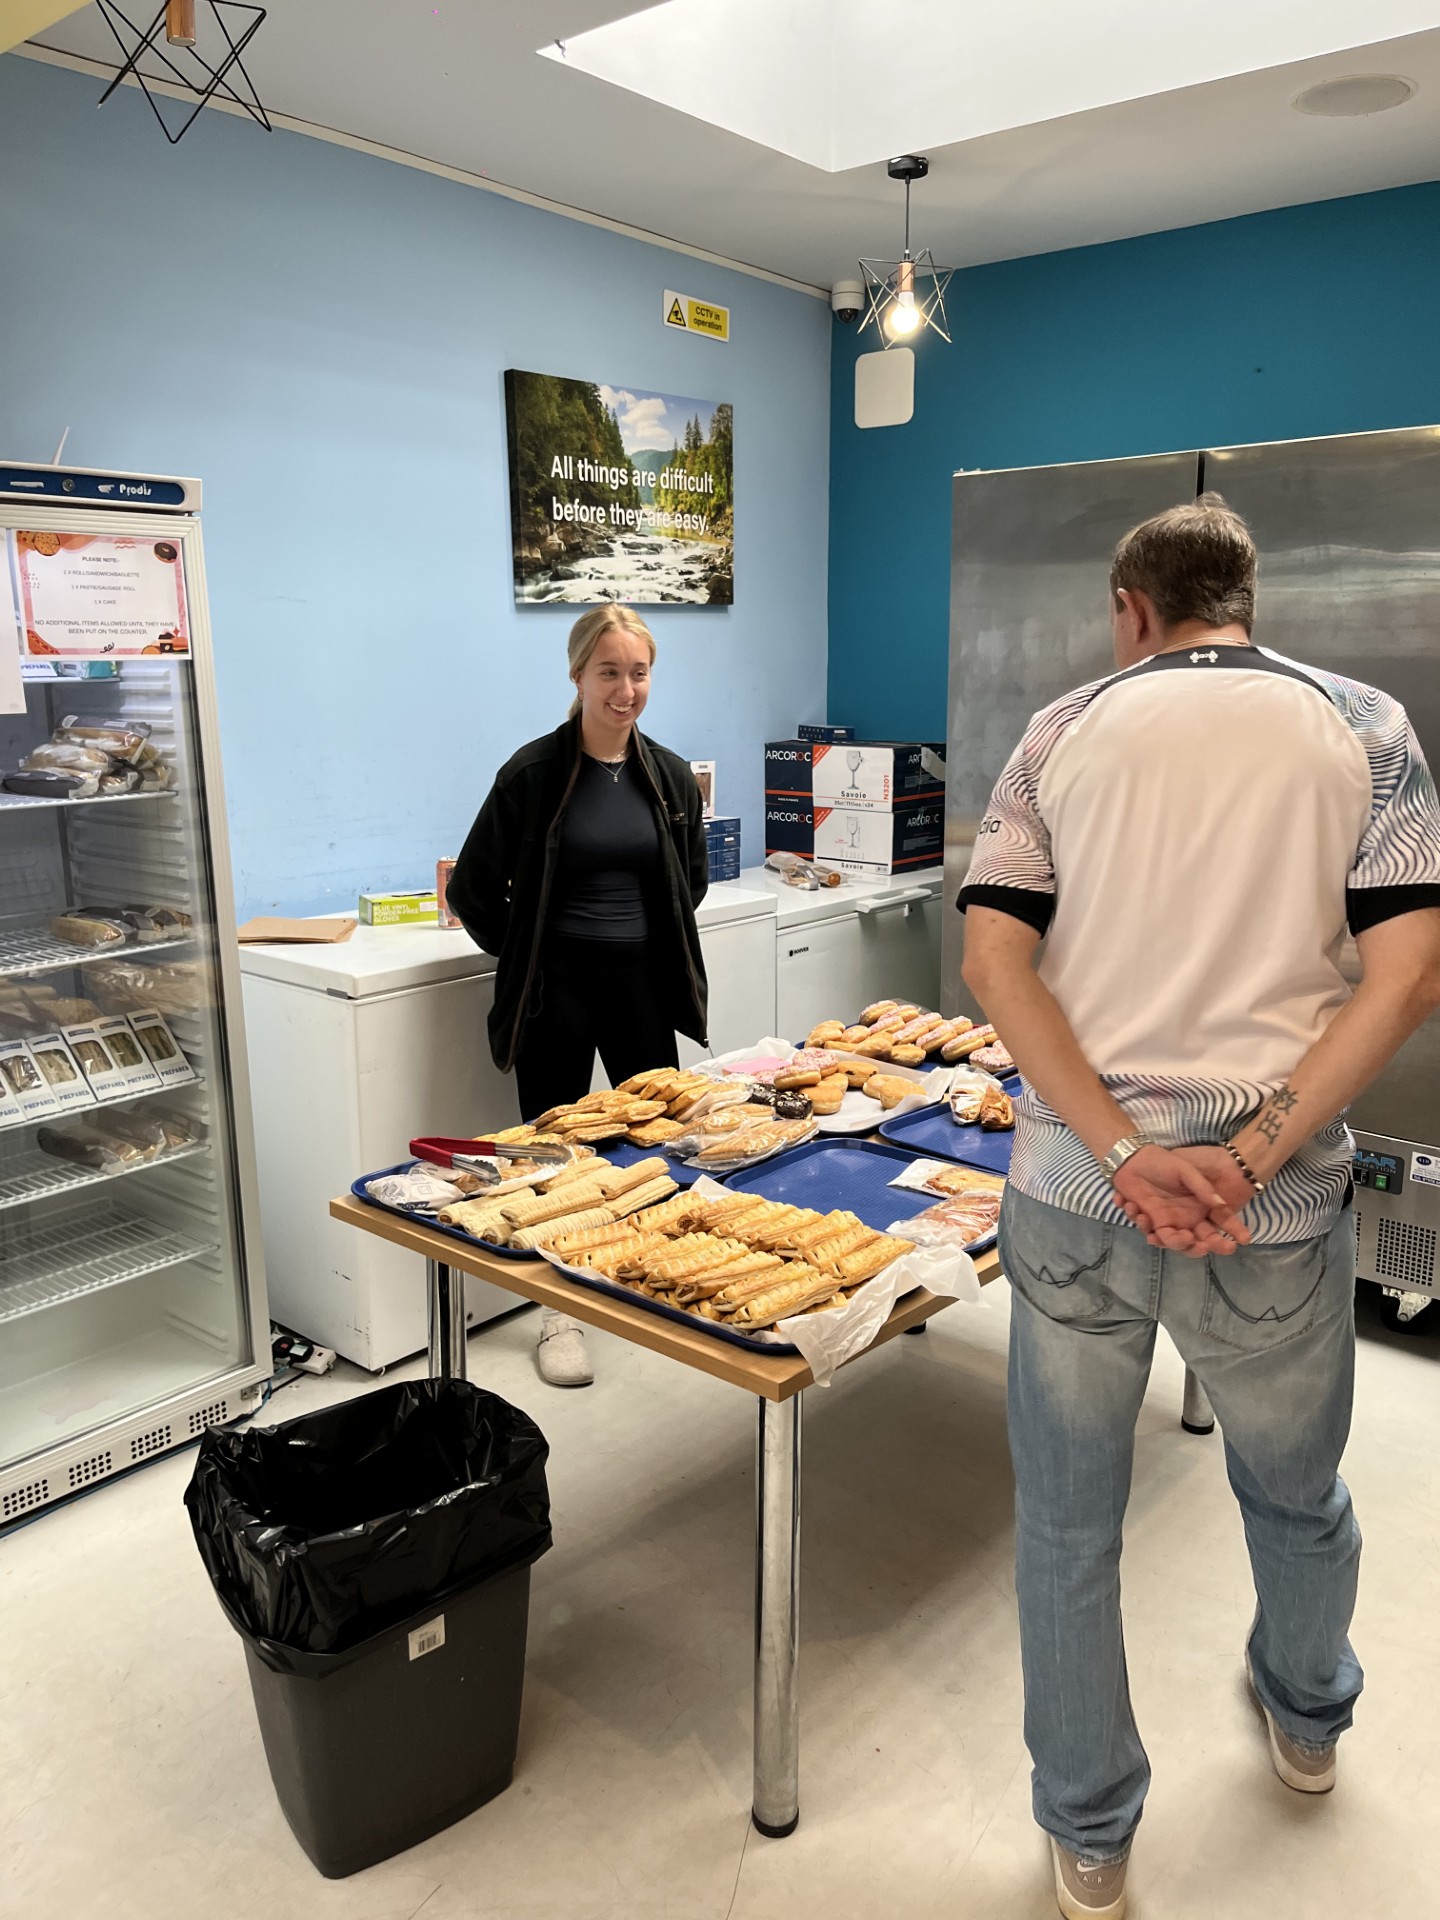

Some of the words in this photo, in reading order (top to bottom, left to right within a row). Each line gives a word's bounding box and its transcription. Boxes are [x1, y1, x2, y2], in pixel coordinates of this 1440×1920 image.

[696, 306, 713, 318] CCTV
[714, 312, 720, 320] in
[694, 318, 722, 332] operation
[551, 456, 574, 480] All
[577, 458, 628, 490] things
[632, 469, 656, 488] are
[660, 468, 714, 494] difficult
[120, 483, 152, 496] Prodis
[552, 496, 606, 524] before
[610, 502, 648, 532] they
[648, 511, 670, 528] are
[674, 513, 710, 536] easy.
[766, 750, 811, 762] ARCOROC
[767, 811, 812, 824] ARCOROC
[373, 909, 419, 917] POWDER-FREE
[161, 1066, 189, 1077] PREPARED
[128, 1074, 156, 1084] PREPARED
[96, 1081, 125, 1091] PREPARED
[59, 1090, 90, 1102] PREPARED
[24, 1099, 56, 1110] PREPARED
[0, 1108, 19, 1117] PARED
[1083, 1875, 1102, 1884] AIR
